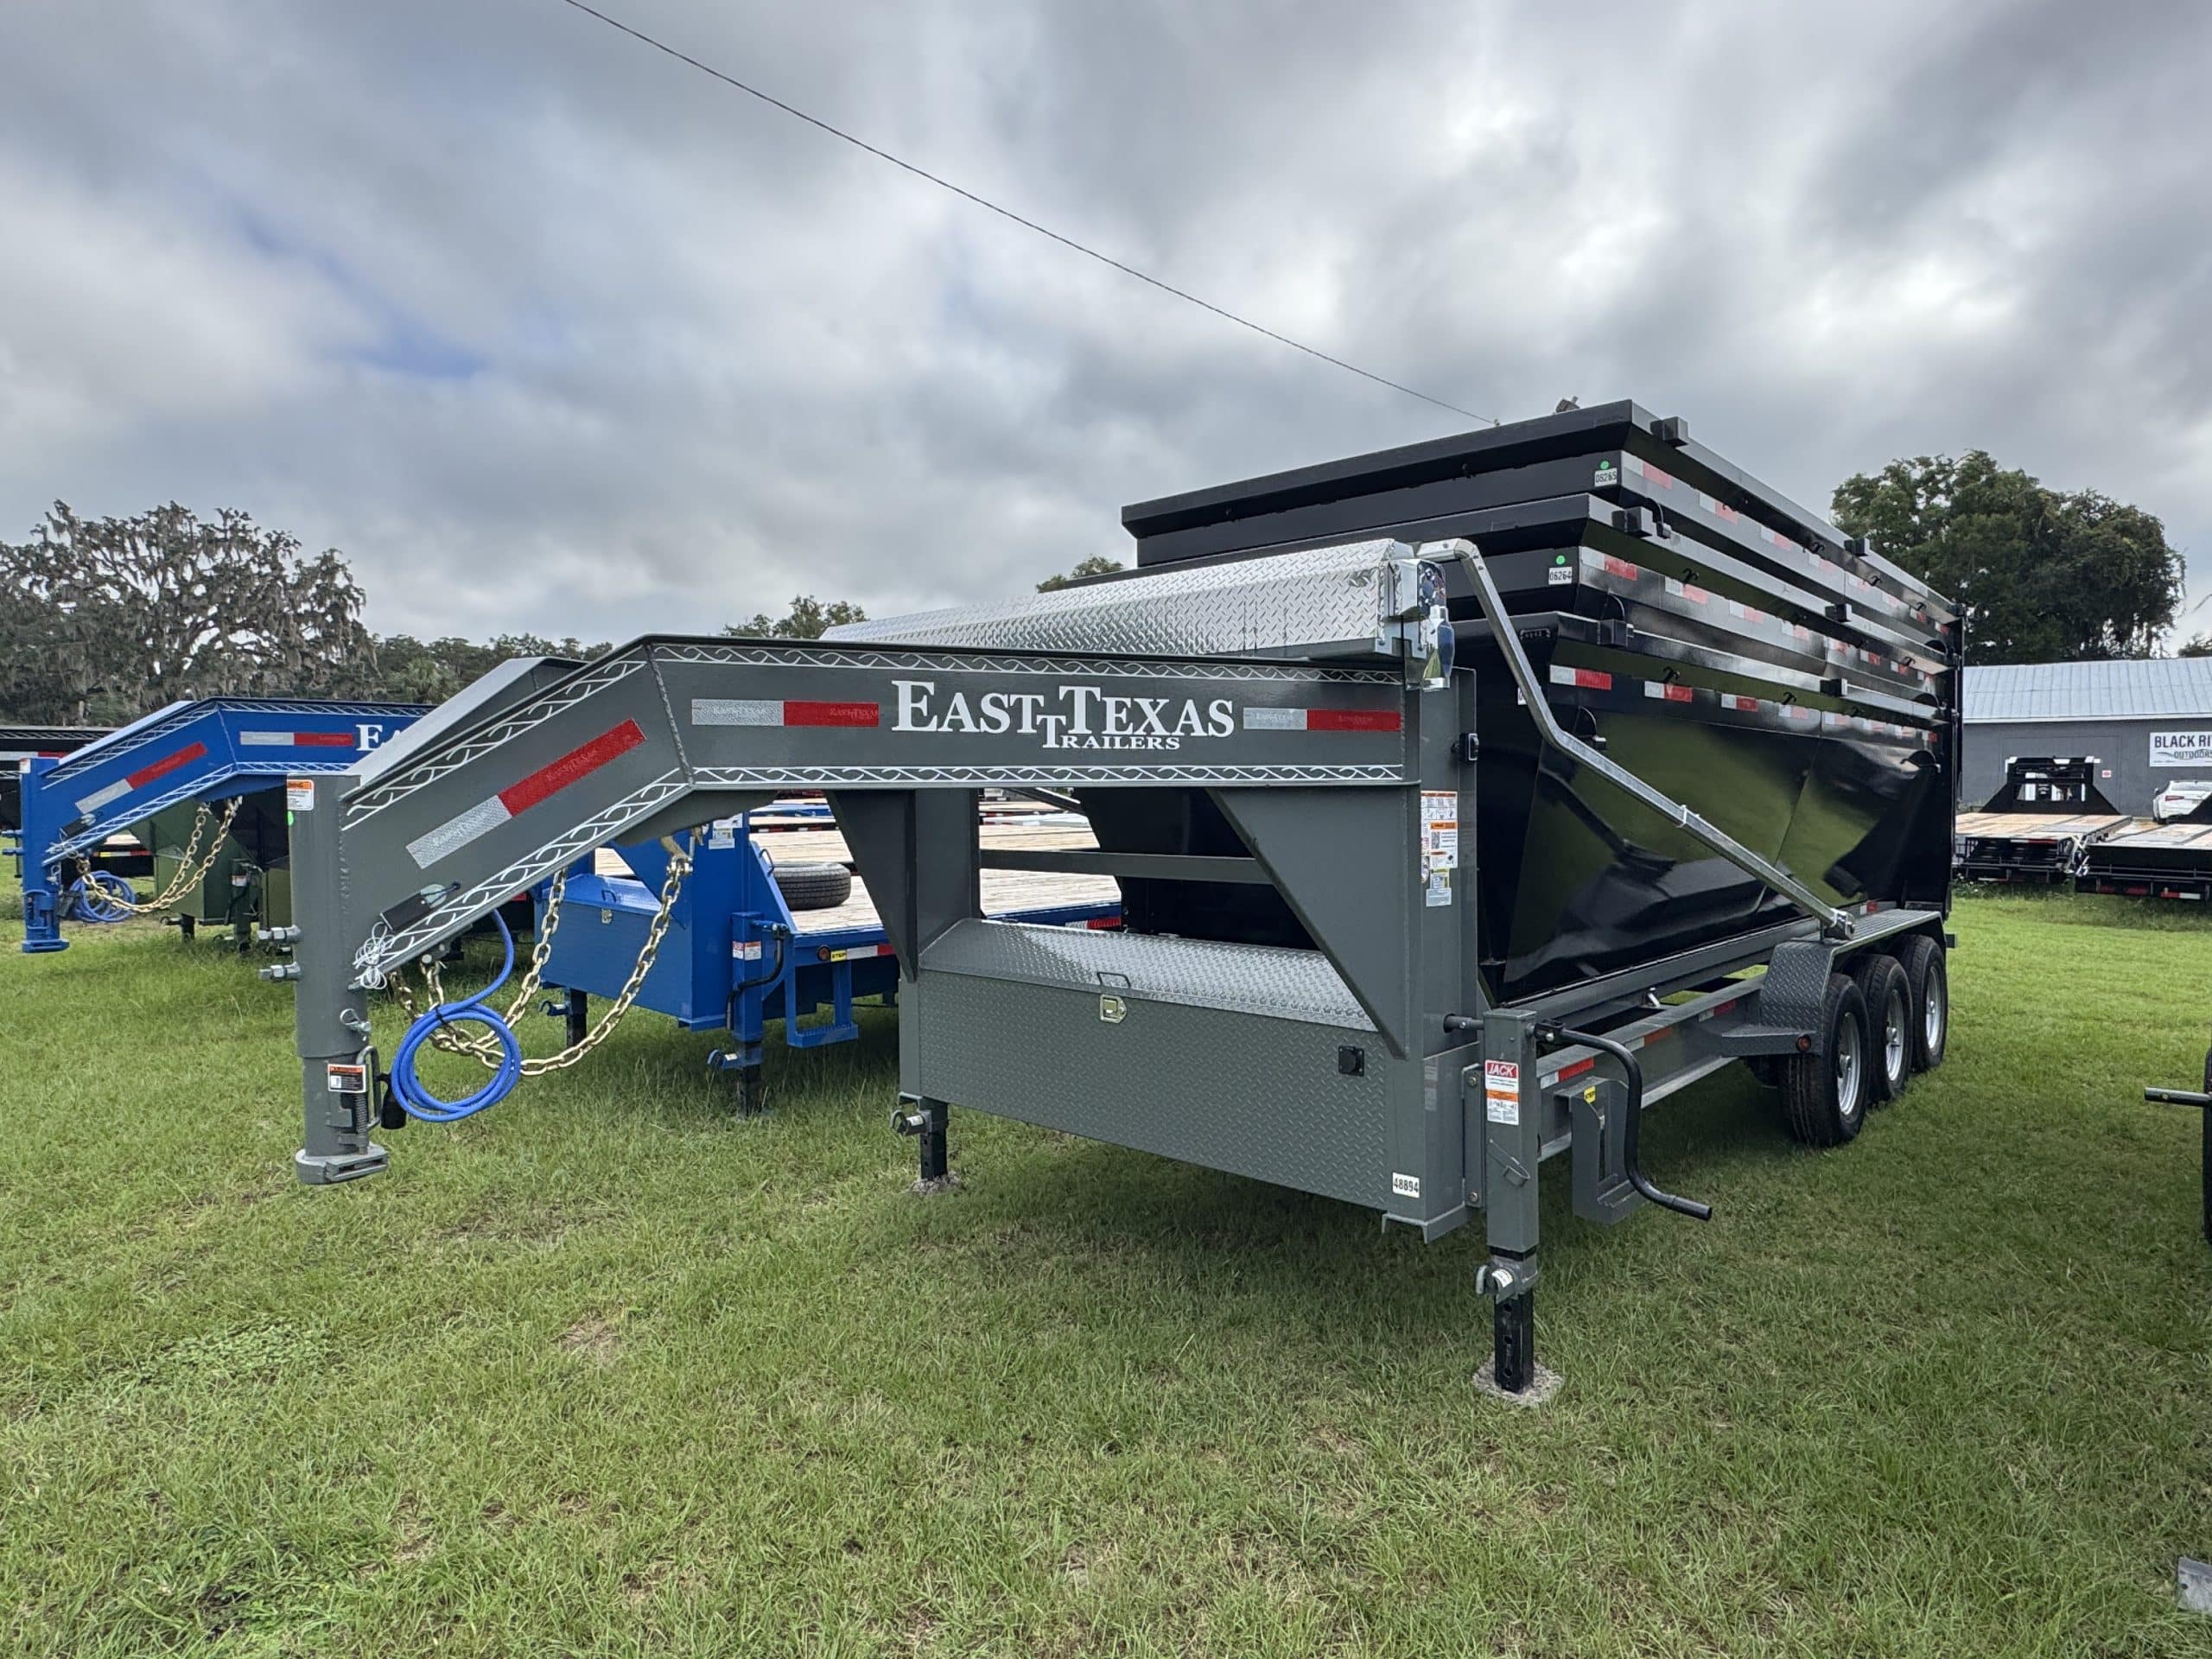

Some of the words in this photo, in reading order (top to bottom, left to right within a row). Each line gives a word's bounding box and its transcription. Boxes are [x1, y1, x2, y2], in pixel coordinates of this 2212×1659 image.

[891, 680, 1044, 734] EAST
[1059, 685, 1235, 737] TEXAS
[1038, 715, 1180, 750] TRAILERS
[2154, 735, 2195, 747] BLACK
[2199, 734, 2212, 747] RI
[1489, 1064, 1515, 1077] JACK
[1394, 1178, 1419, 1192] 48894
